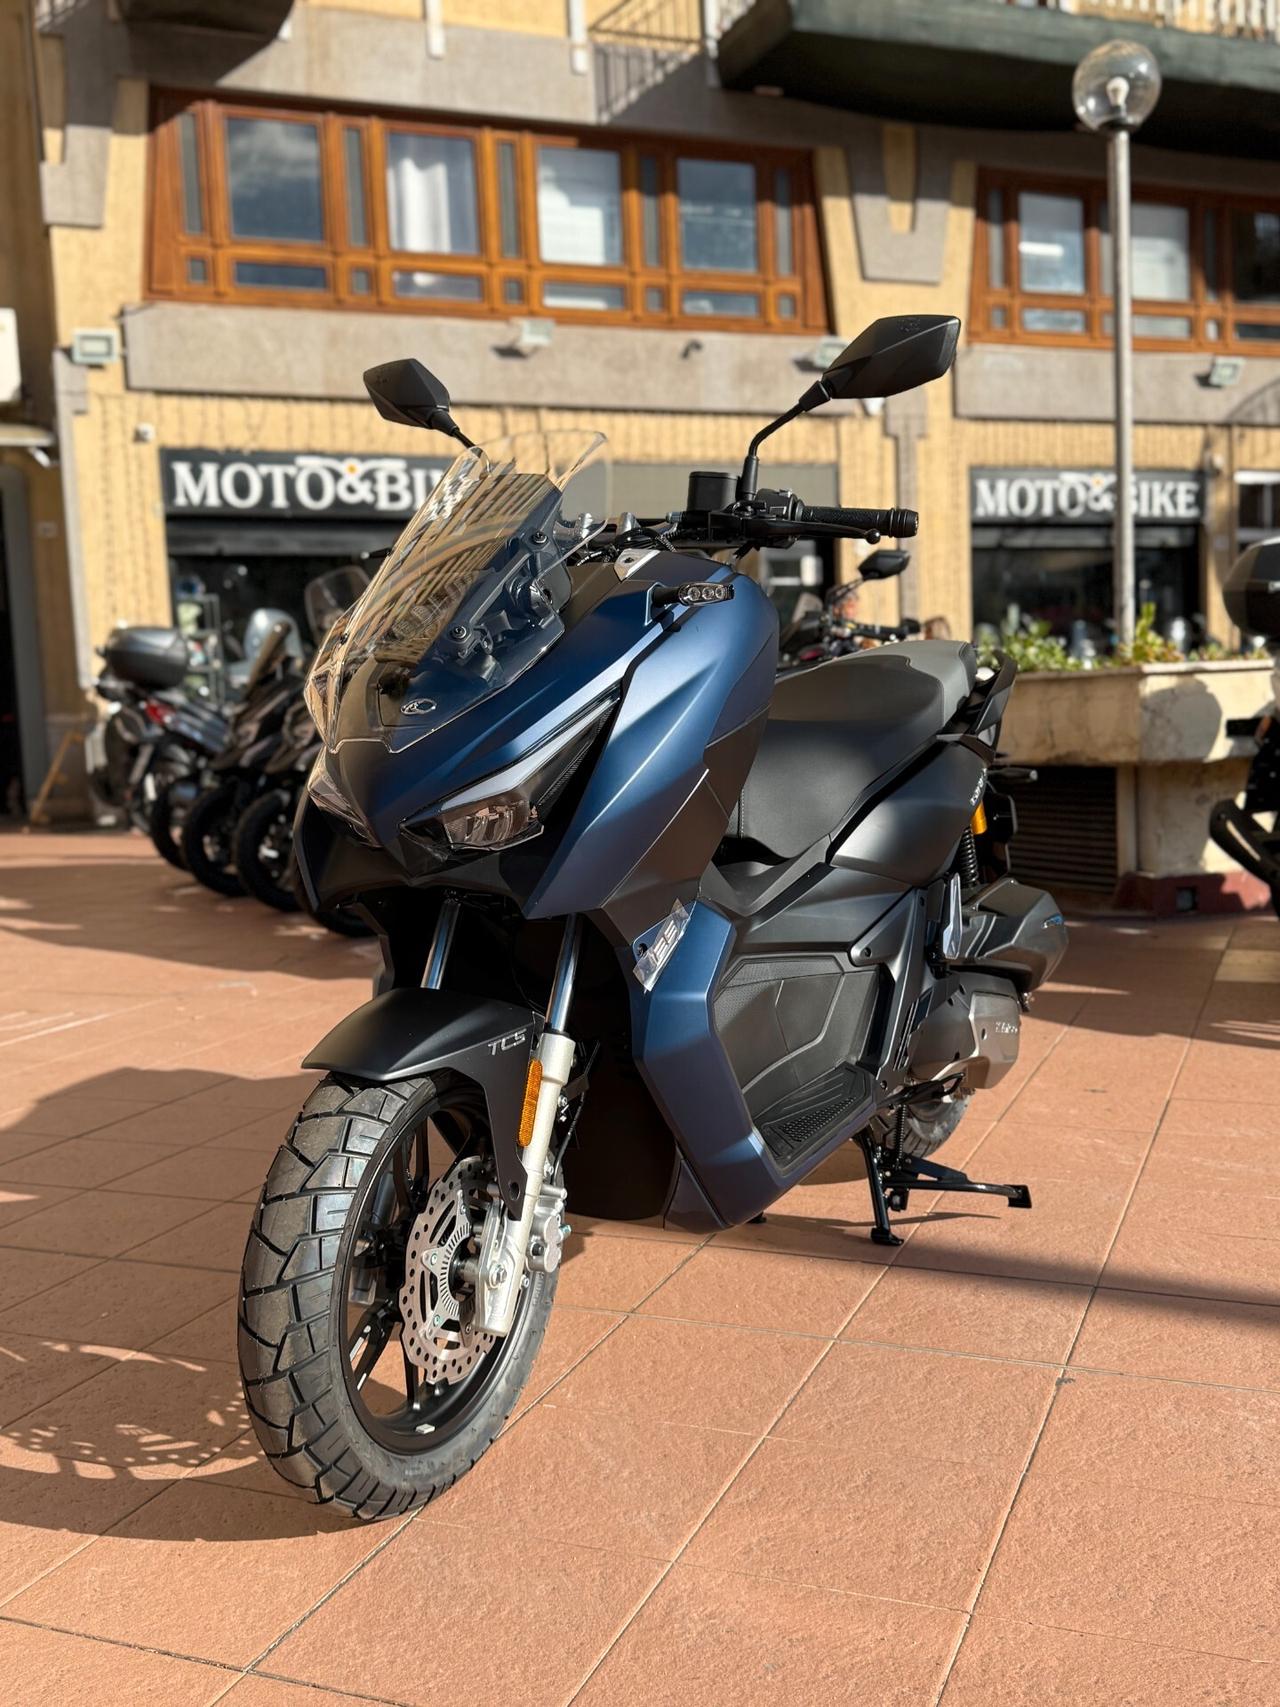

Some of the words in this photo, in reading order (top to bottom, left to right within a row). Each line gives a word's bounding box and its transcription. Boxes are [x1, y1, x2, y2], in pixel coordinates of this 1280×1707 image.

[171, 457, 445, 510] MOTO&BI
[975, 473, 1199, 517] MOTO&IKE
[487, 1028, 527, 1055] TCS
